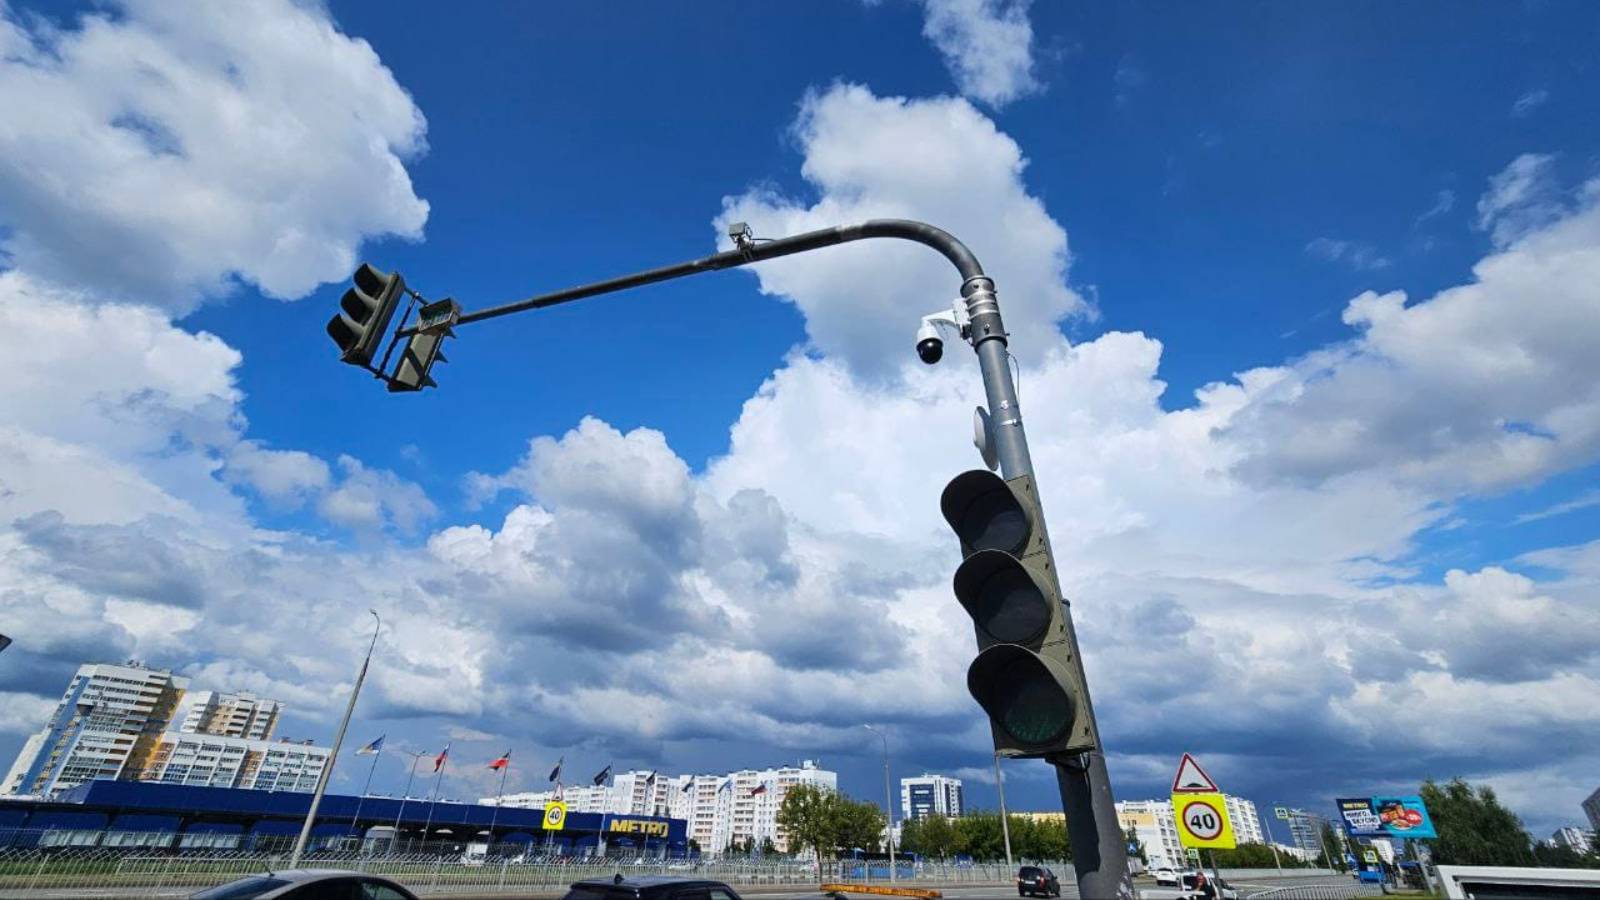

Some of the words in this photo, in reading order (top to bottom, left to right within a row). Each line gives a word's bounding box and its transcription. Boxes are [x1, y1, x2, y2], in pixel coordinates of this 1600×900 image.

[549, 811, 560, 820] 40
[1191, 813, 1215, 829] 40
[610, 819, 669, 838] METRO
